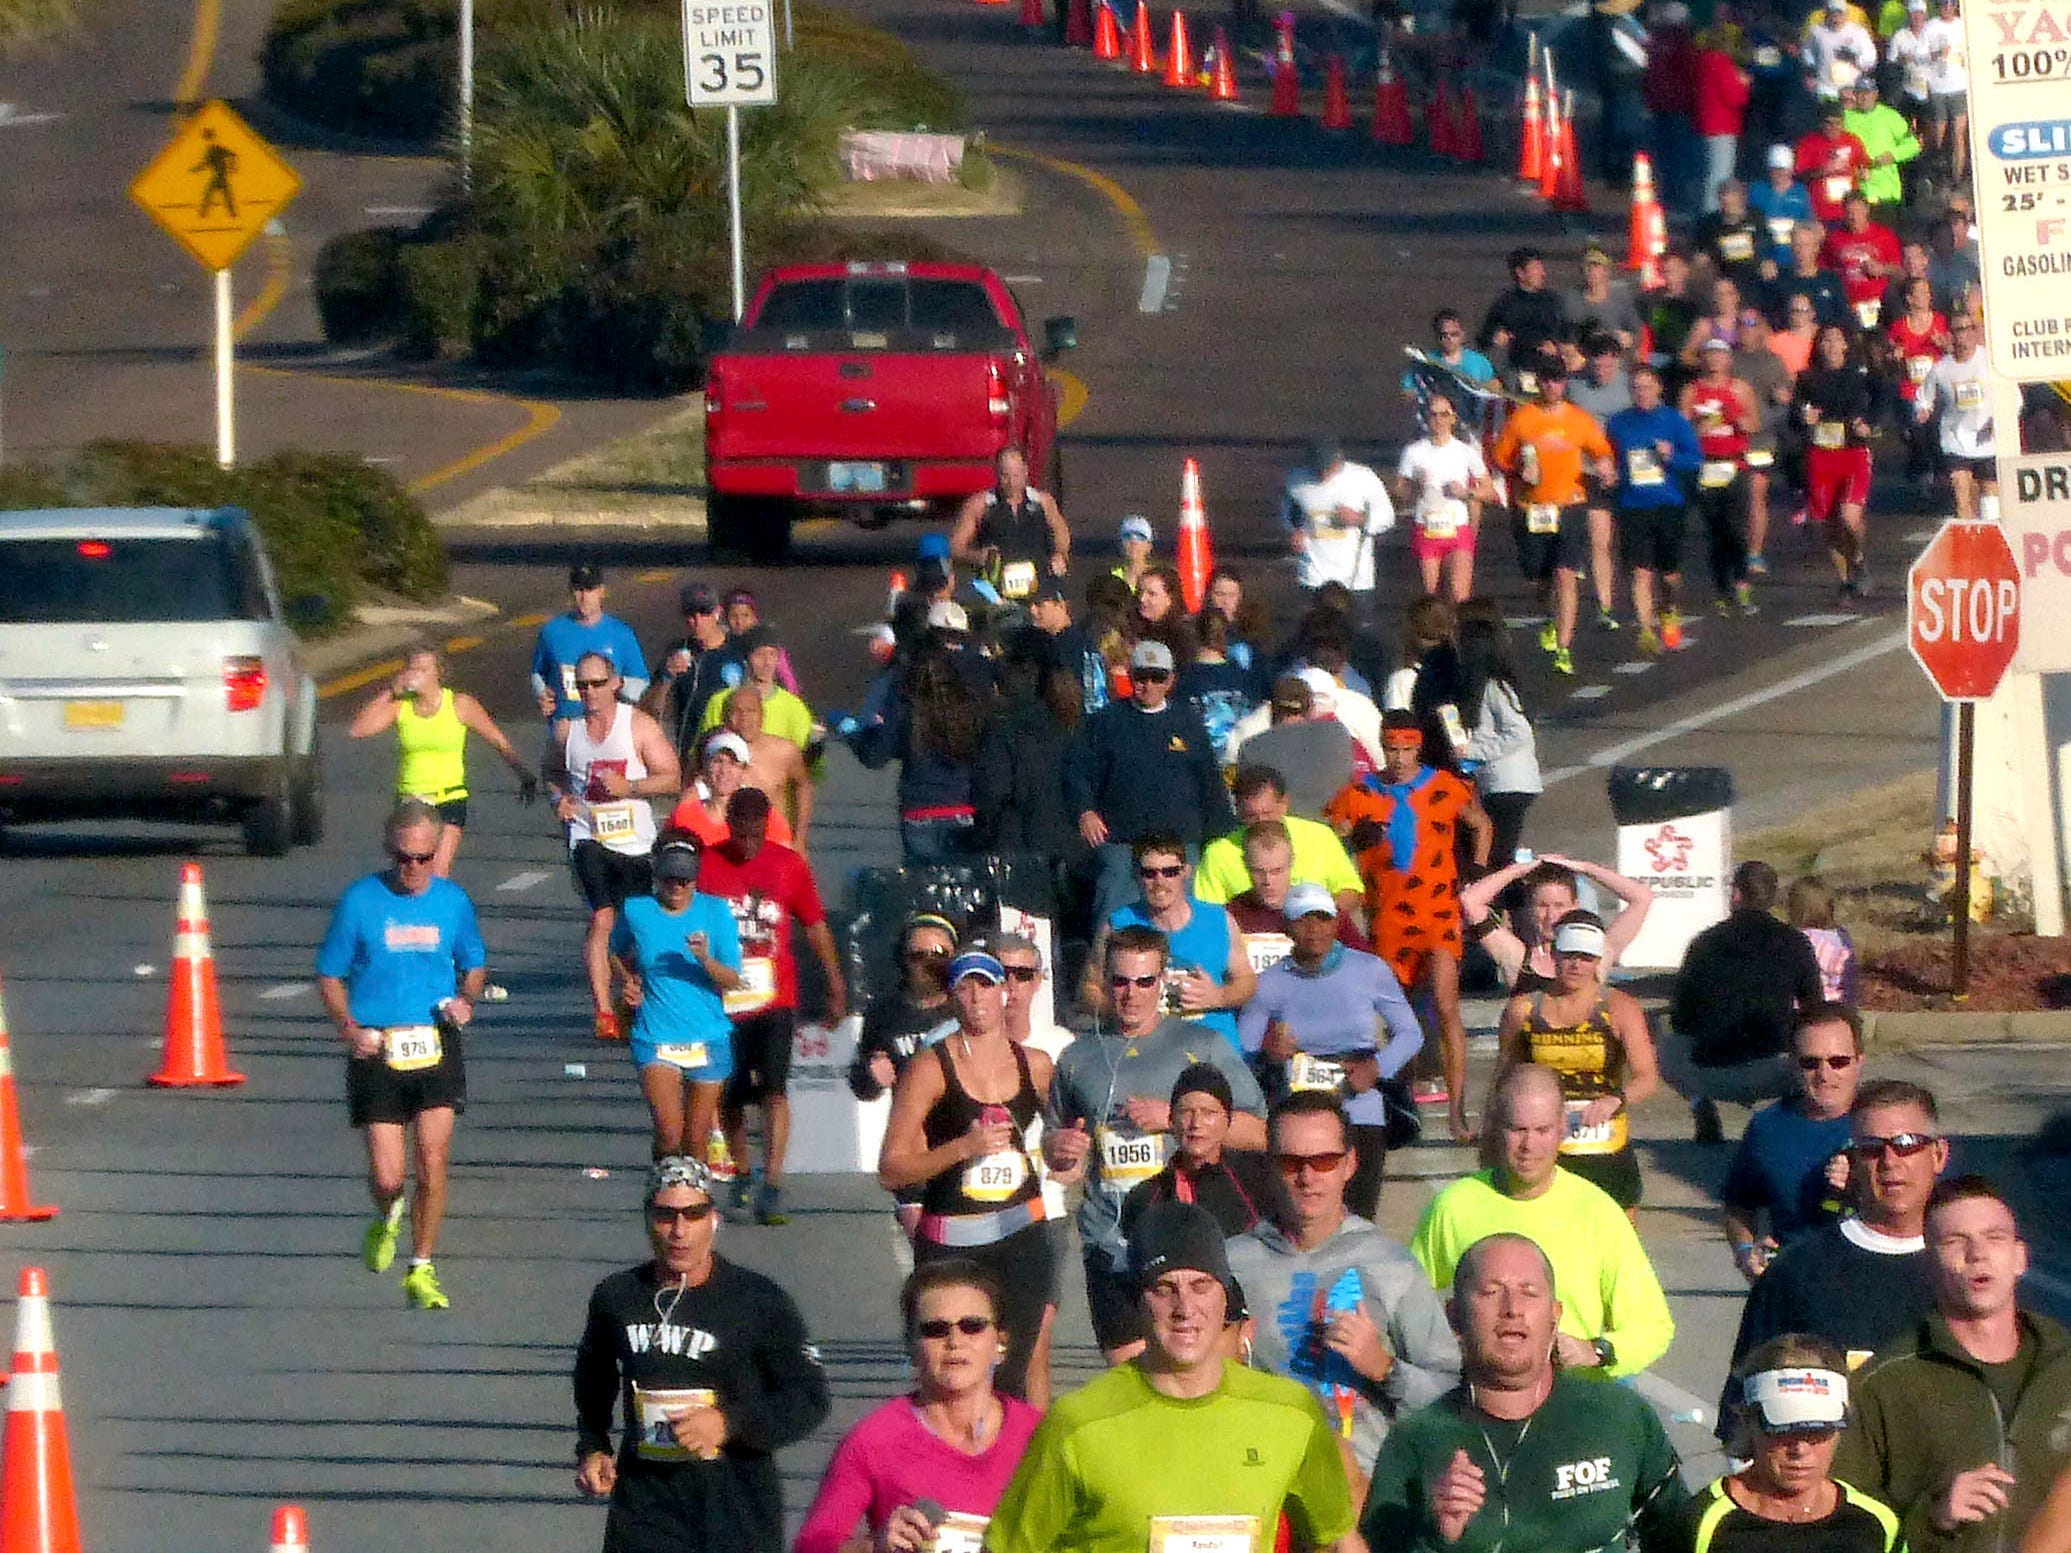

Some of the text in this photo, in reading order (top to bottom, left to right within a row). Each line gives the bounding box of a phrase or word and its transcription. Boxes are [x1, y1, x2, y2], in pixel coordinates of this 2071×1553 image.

[692, 7, 763, 24] SPEED
[1987, 8, 2071, 46] YA
[701, 29, 755, 47] LIMIT
[700, 53, 763, 92] 35
[2004, 164, 2049, 185] WET
[2012, 319, 2058, 337] CLUB
[2017, 465, 2071, 503] DR
[1918, 578, 2017, 643] STOP
[1628, 876, 1717, 888] EPUBLIC
[1109, 1143, 1150, 1164] 1956
[980, 1167, 1012, 1184] 879
[626, 1323, 717, 1360] WWP
[1556, 1457, 1611, 1490] FOF
